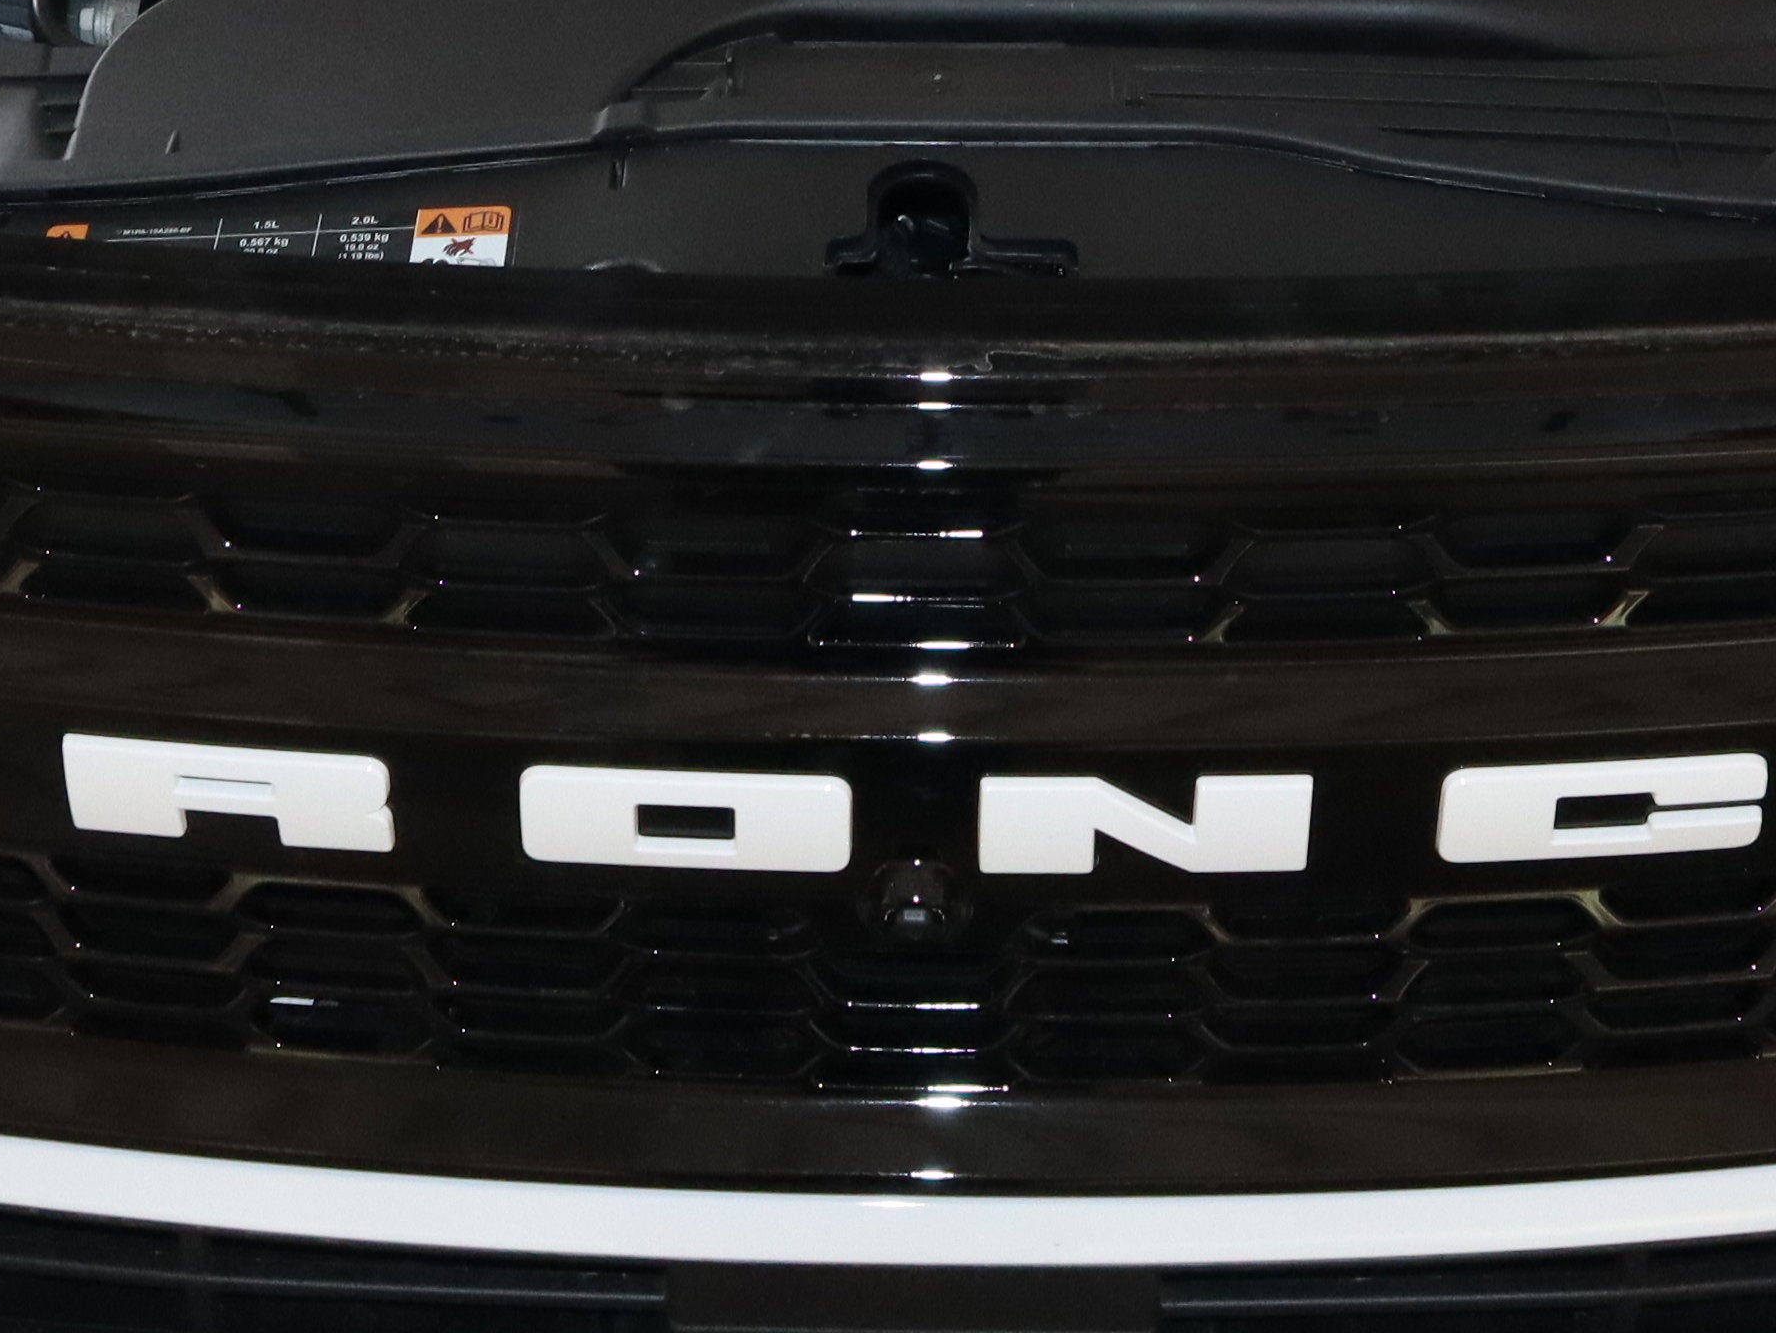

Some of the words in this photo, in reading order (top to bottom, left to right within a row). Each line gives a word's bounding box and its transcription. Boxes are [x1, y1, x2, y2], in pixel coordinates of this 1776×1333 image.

[253, 220, 280, 230] 1.5L
[350, 216, 379, 226] 2.0L
[239, 237, 271, 248] 0.567
[274, 236, 289, 248] kg
[339, 233, 371, 243] 0.539
[373, 231, 390, 243] kg
